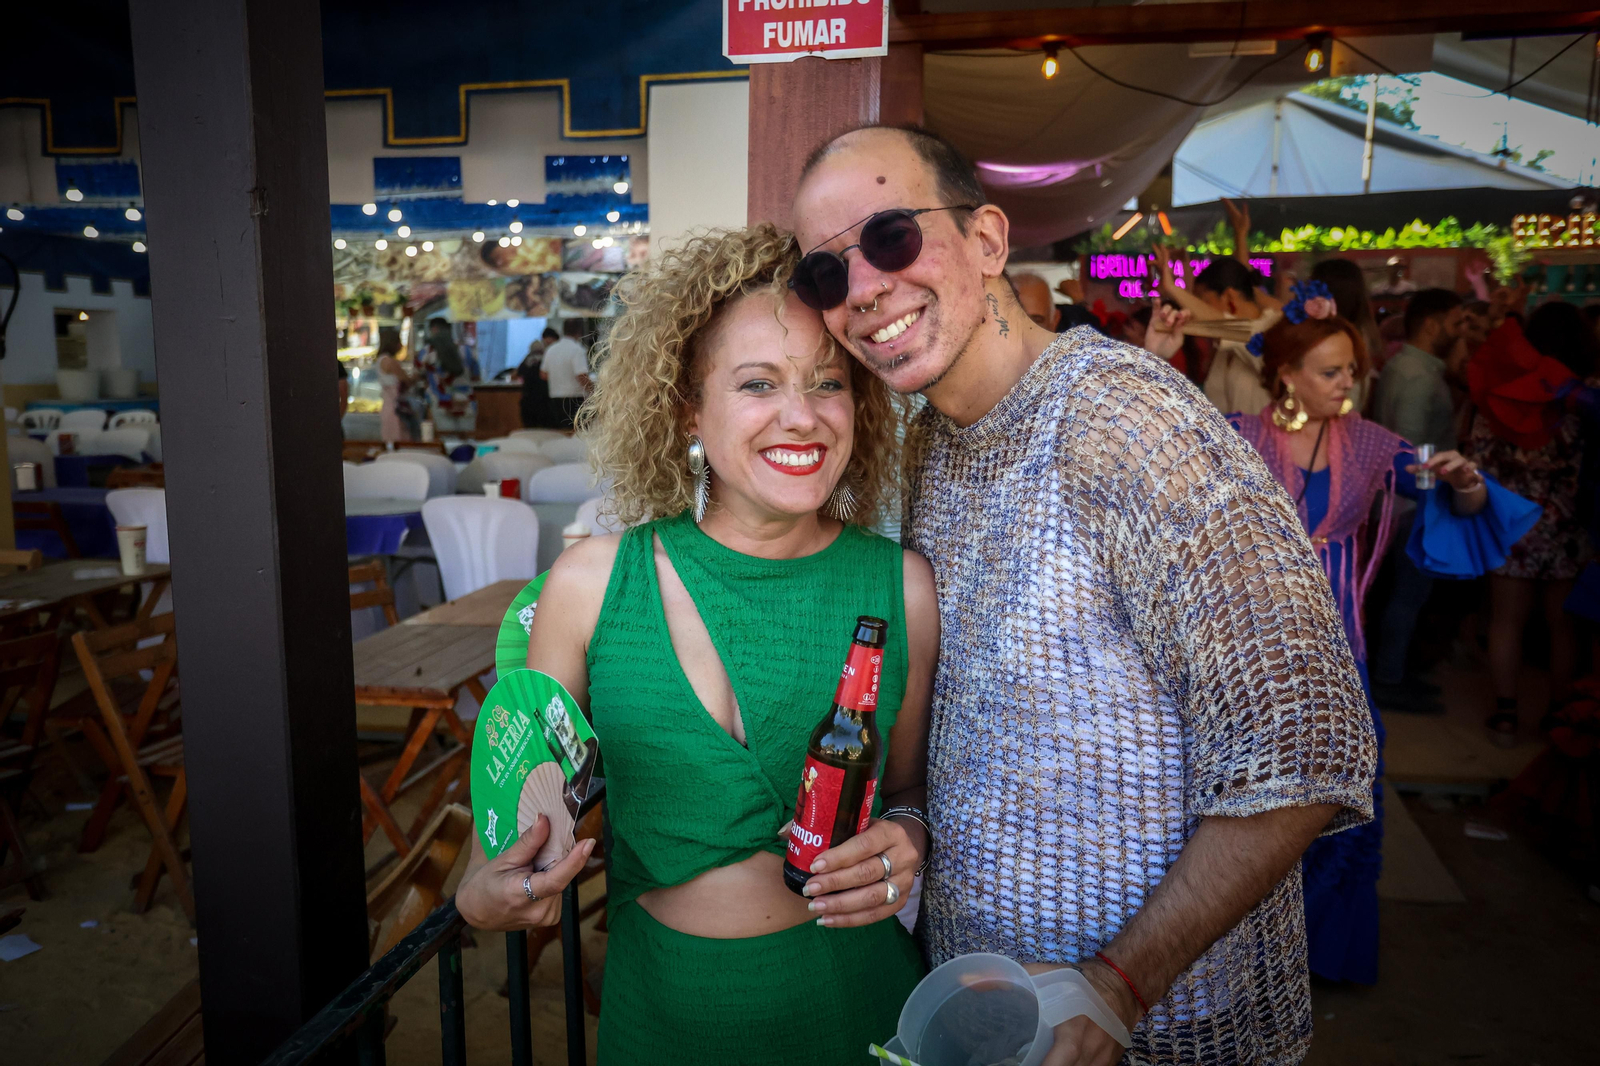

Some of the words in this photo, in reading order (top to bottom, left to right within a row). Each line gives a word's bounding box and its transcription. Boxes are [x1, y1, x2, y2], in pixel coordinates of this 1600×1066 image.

[763, 18, 846, 48] FUMAR
[842, 662, 855, 676] EN
[486, 755, 506, 785] LA
[498, 709, 531, 763] FERIA
